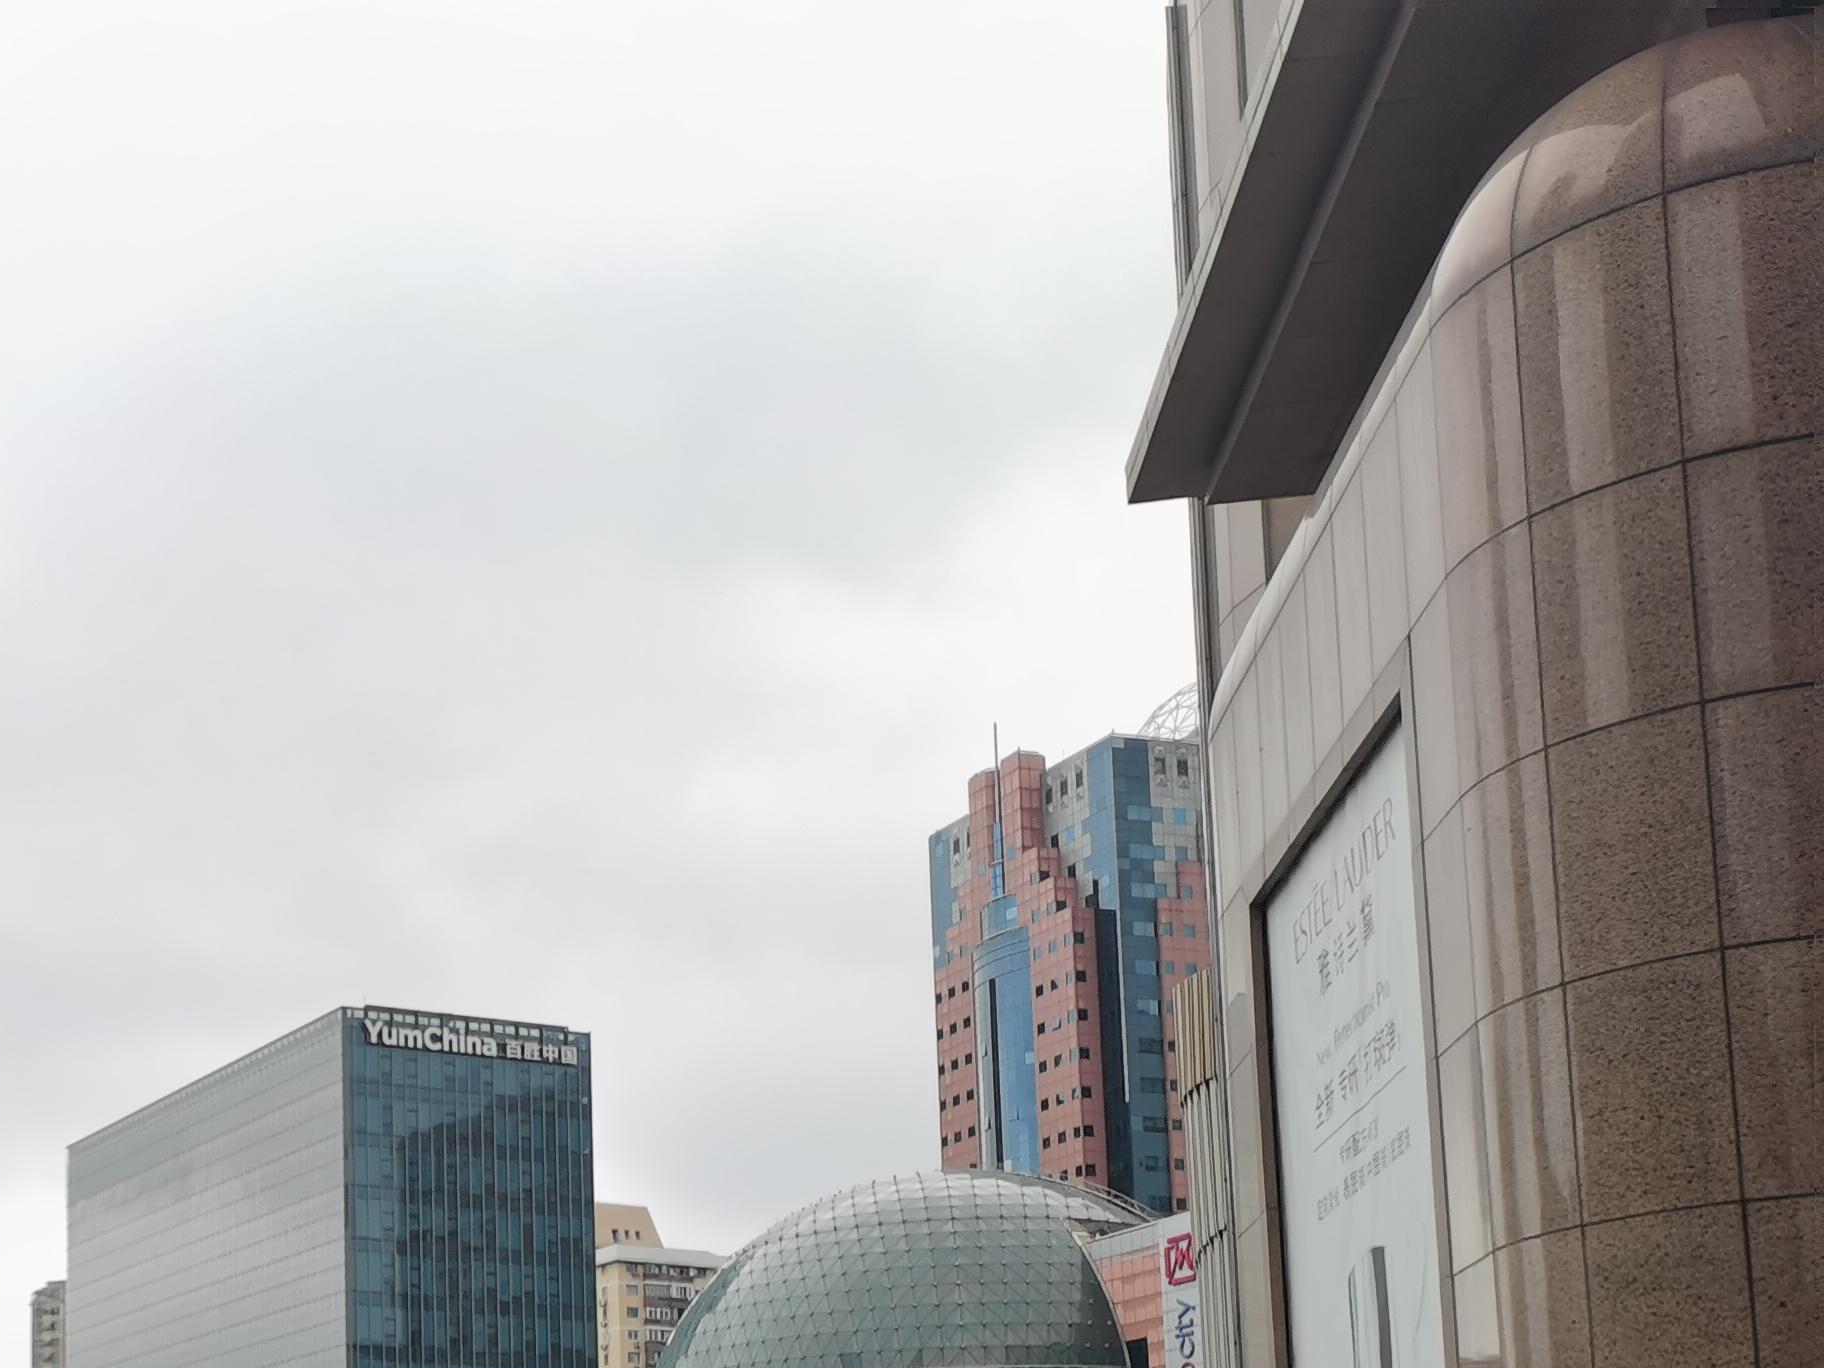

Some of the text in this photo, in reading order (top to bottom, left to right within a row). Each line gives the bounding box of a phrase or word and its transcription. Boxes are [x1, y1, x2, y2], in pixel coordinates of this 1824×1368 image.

[1292, 797, 1397, 965] ESTÉE LAUDER
[505, 1038, 577, 1066] 百胜中国
